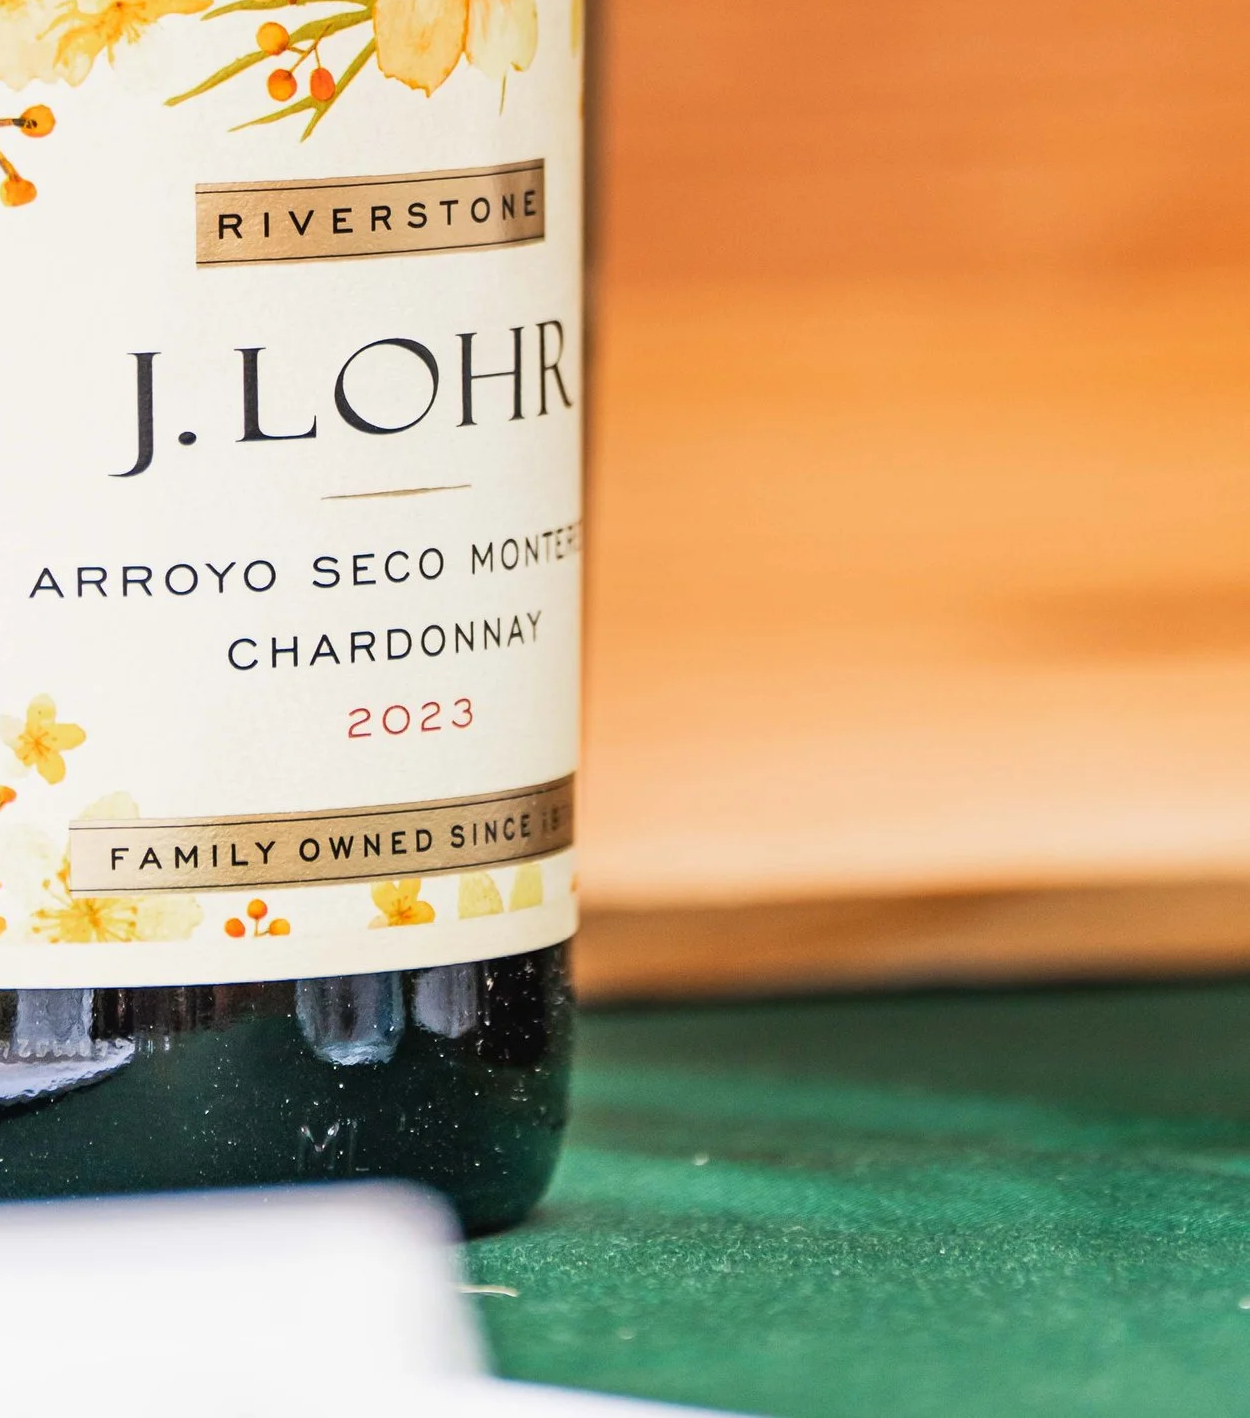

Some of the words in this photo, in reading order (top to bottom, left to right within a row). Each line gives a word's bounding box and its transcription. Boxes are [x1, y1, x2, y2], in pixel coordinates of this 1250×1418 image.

[217, 189, 537, 239] RIVERSTONE
[28, 558, 278, 599] ARROYO
[311, 546, 445, 588] SECO
[227, 609, 544, 671] CHARDONNAY
[347, 697, 475, 739] 2023
[109, 840, 276, 871] FAMILY
[298, 829, 434, 863] OWNED
[450, 813, 531, 848] SINCE
